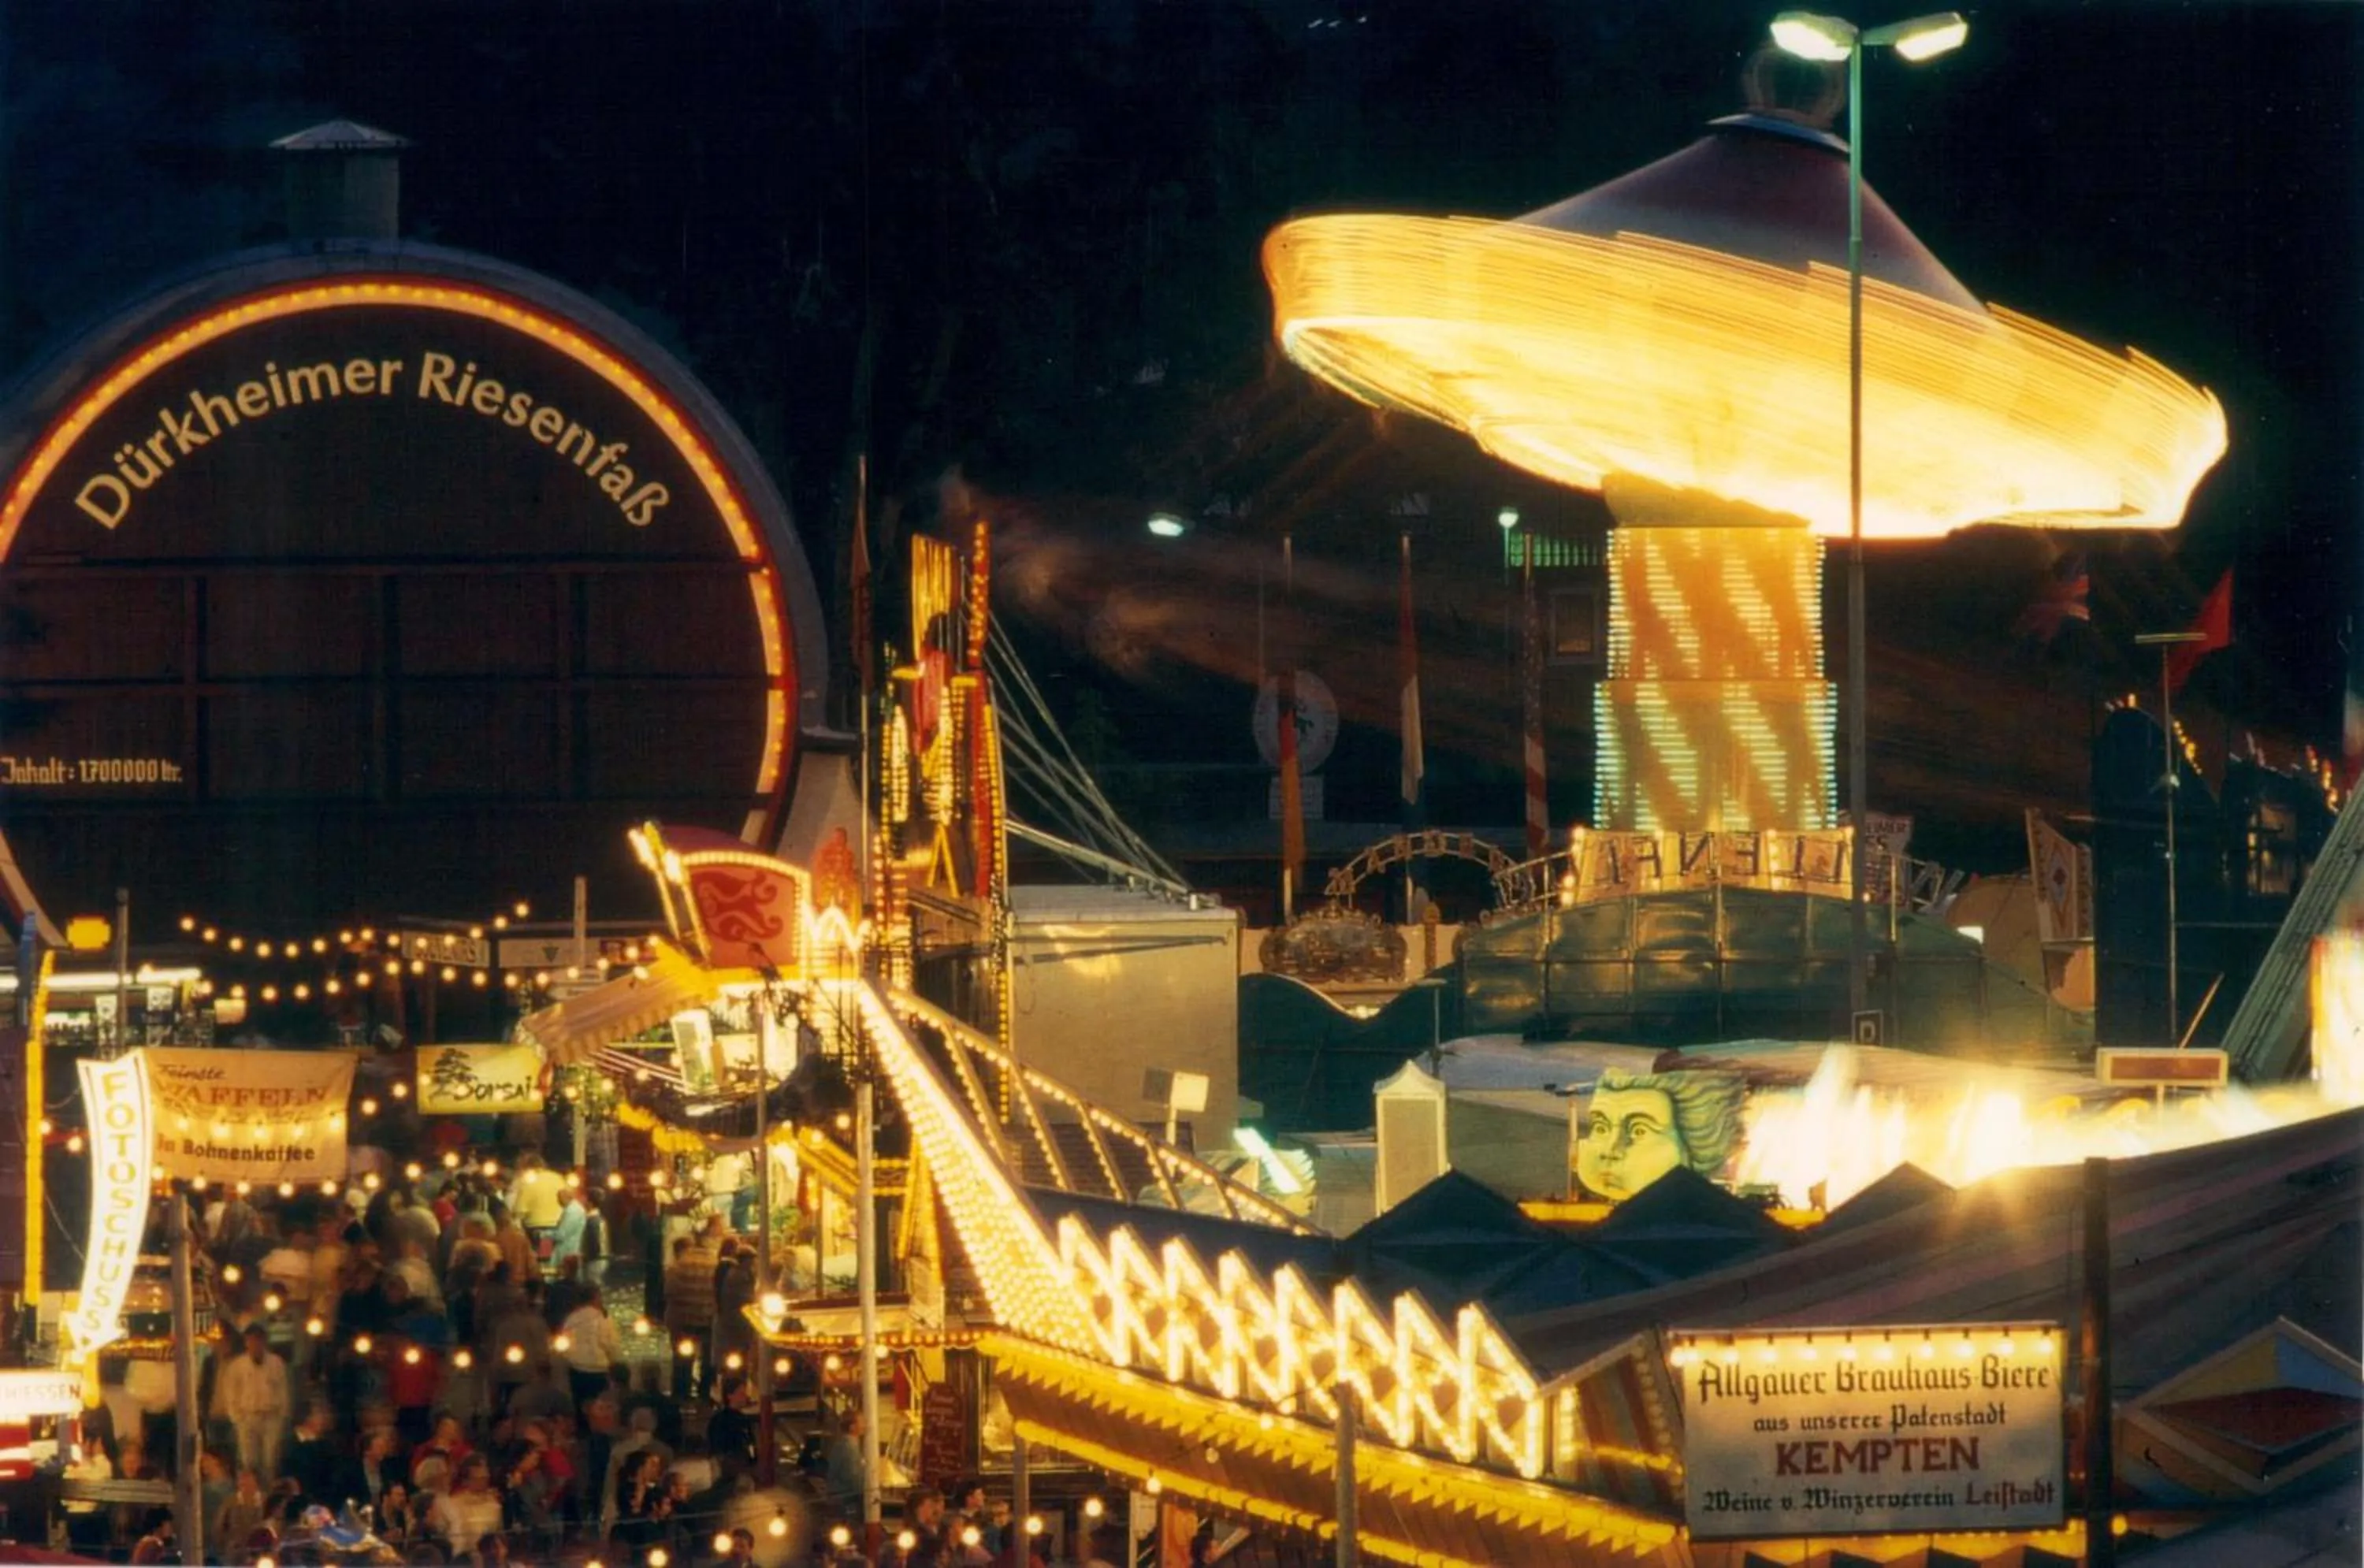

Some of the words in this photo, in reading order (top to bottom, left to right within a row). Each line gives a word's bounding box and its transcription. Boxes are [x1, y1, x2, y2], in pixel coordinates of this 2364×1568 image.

[75, 357, 402, 529] Dürkheimer
[418, 351, 670, 527] Riesenfaß
[183, 1139, 315, 1162] Bohnenkaffee
[85, 1071, 136, 1331] FOTOSCHUSS
[1753, 1416, 1790, 1432] aus
[1801, 1414, 1883, 1430] unserer
[1890, 1401, 2007, 1434] Patenstadt
[1775, 1436, 1980, 1477] KEMPTEN
[1702, 1488, 1774, 1514] Weine
[1801, 1484, 1954, 1515] Winzerverein
